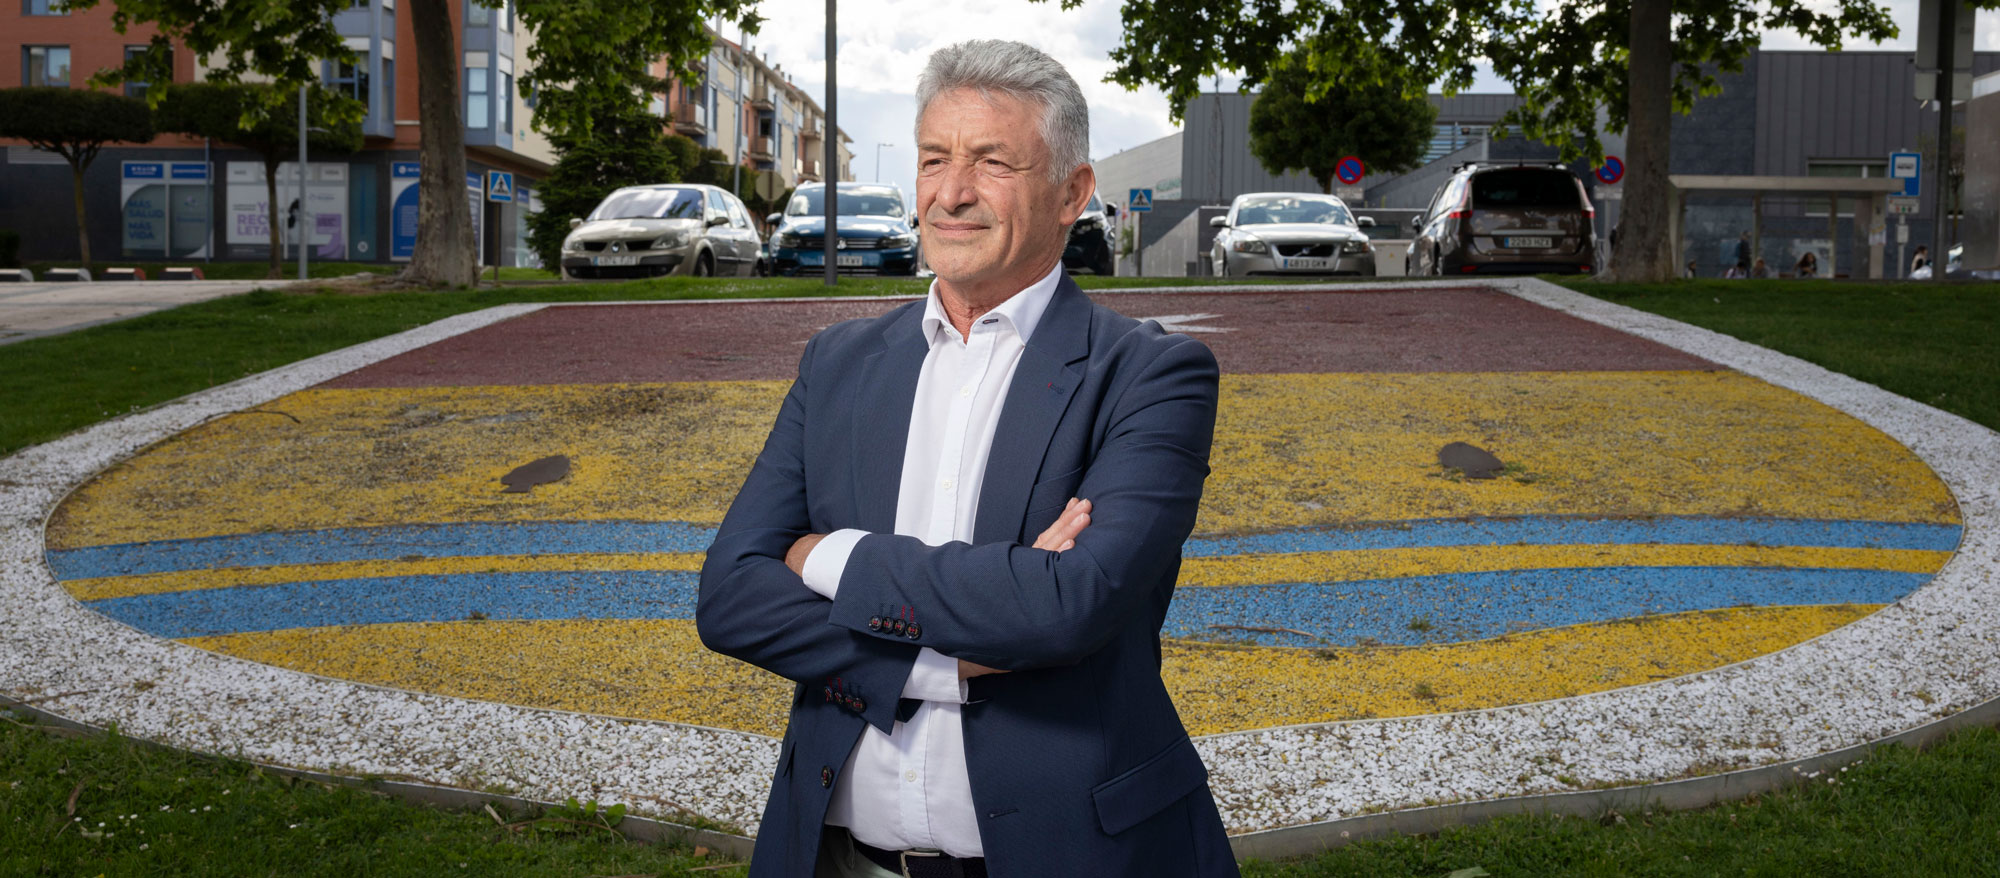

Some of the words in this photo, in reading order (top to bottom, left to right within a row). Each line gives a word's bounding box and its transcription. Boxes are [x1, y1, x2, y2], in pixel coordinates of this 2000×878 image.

[257, 202, 268, 213] Y
[128, 209, 164, 218] SALUD
[237, 214, 270, 225] REC
[128, 231, 155, 240] VIDA
[237, 226, 271, 236] LETA
